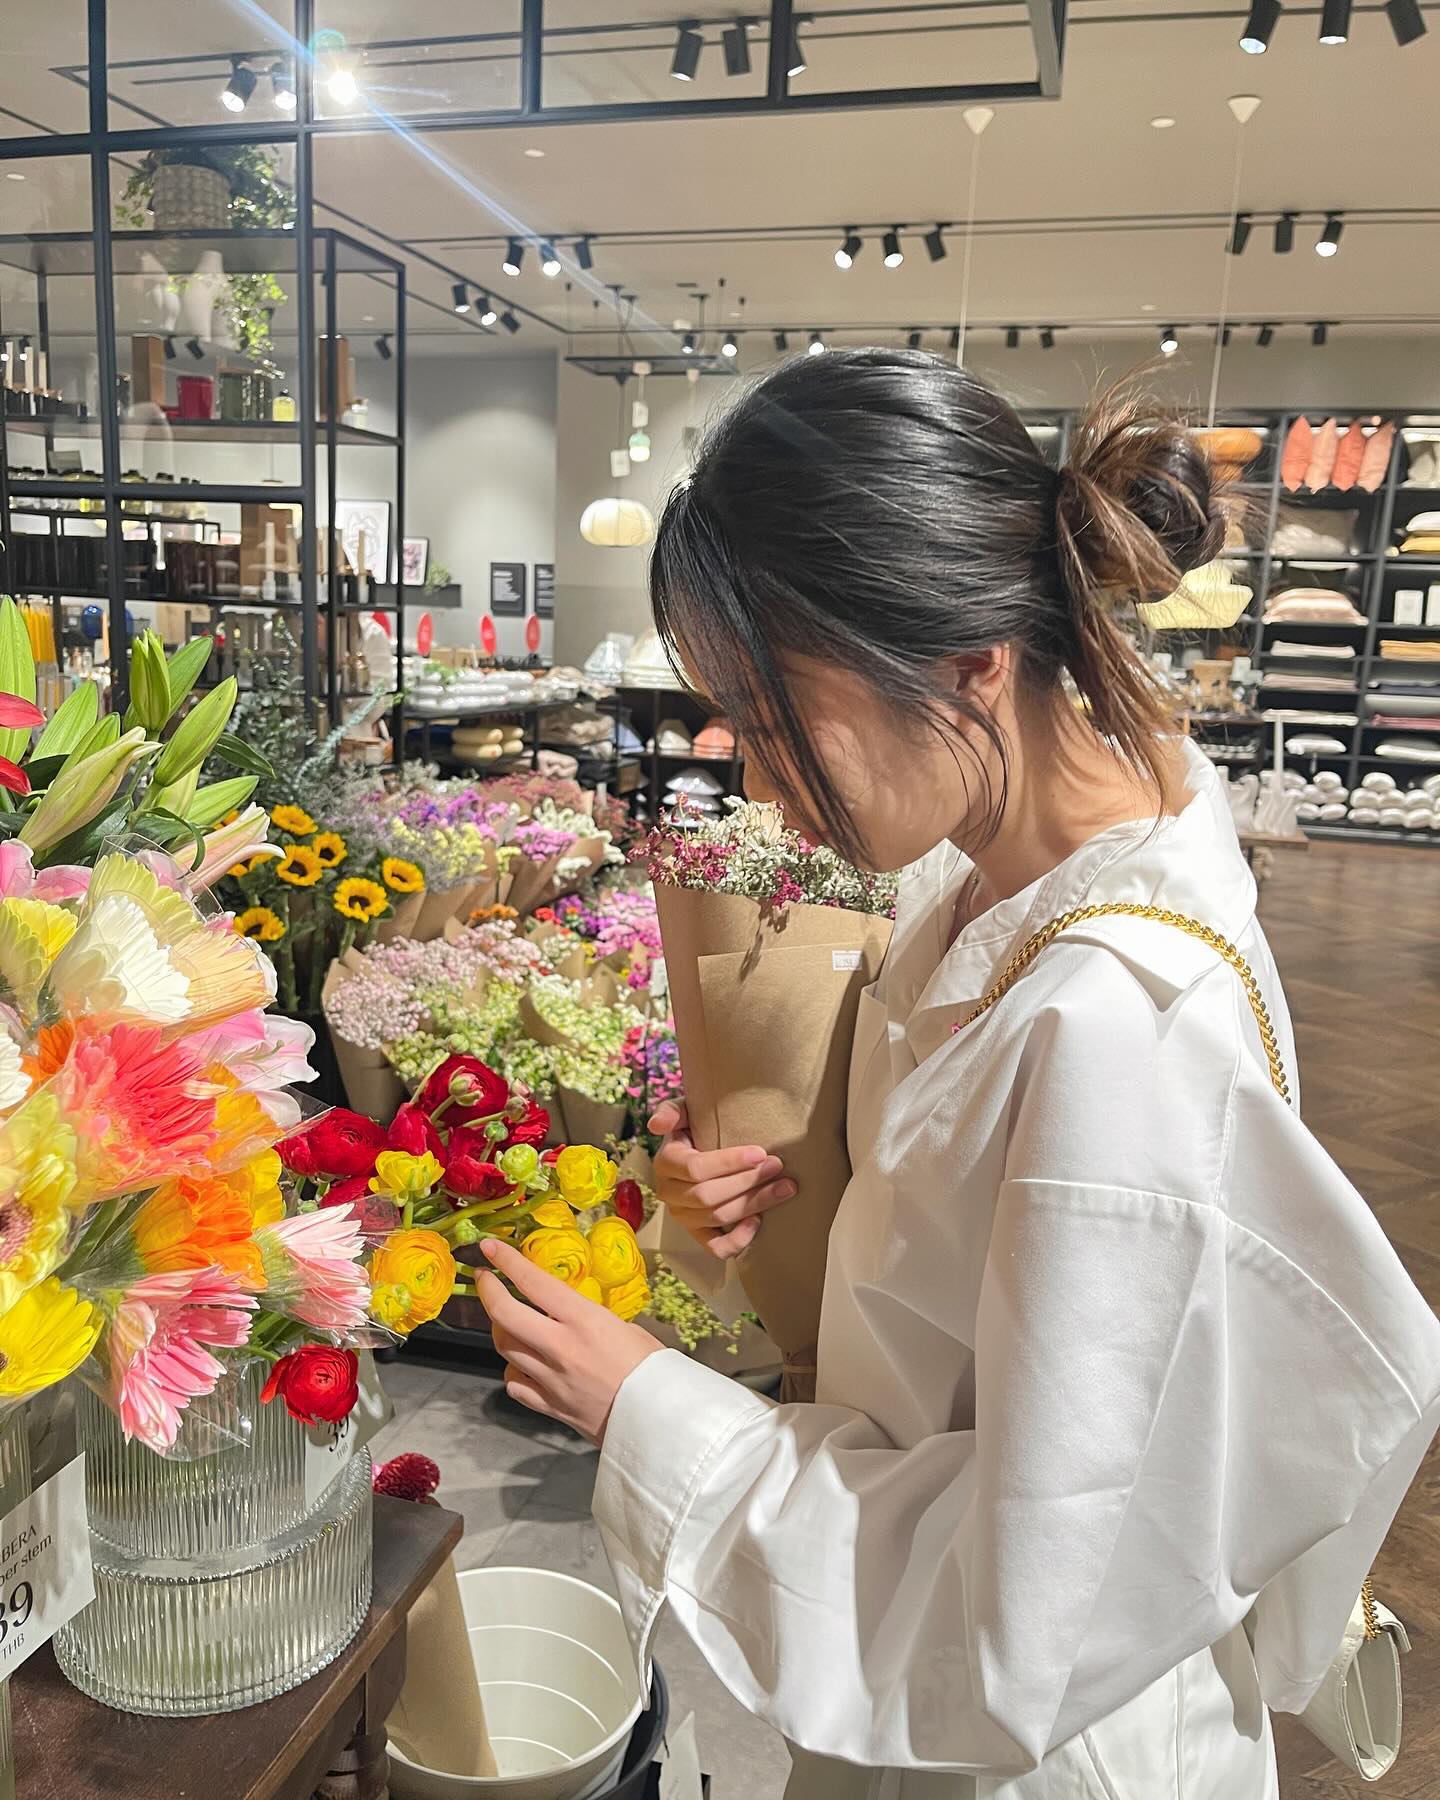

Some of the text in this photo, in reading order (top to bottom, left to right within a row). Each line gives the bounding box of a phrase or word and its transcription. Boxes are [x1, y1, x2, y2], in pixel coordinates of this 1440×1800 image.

[0, 1525, 37, 1564] BERA
[21, 1534, 52, 1568] stem
[3, 1633, 25, 1660] THB
